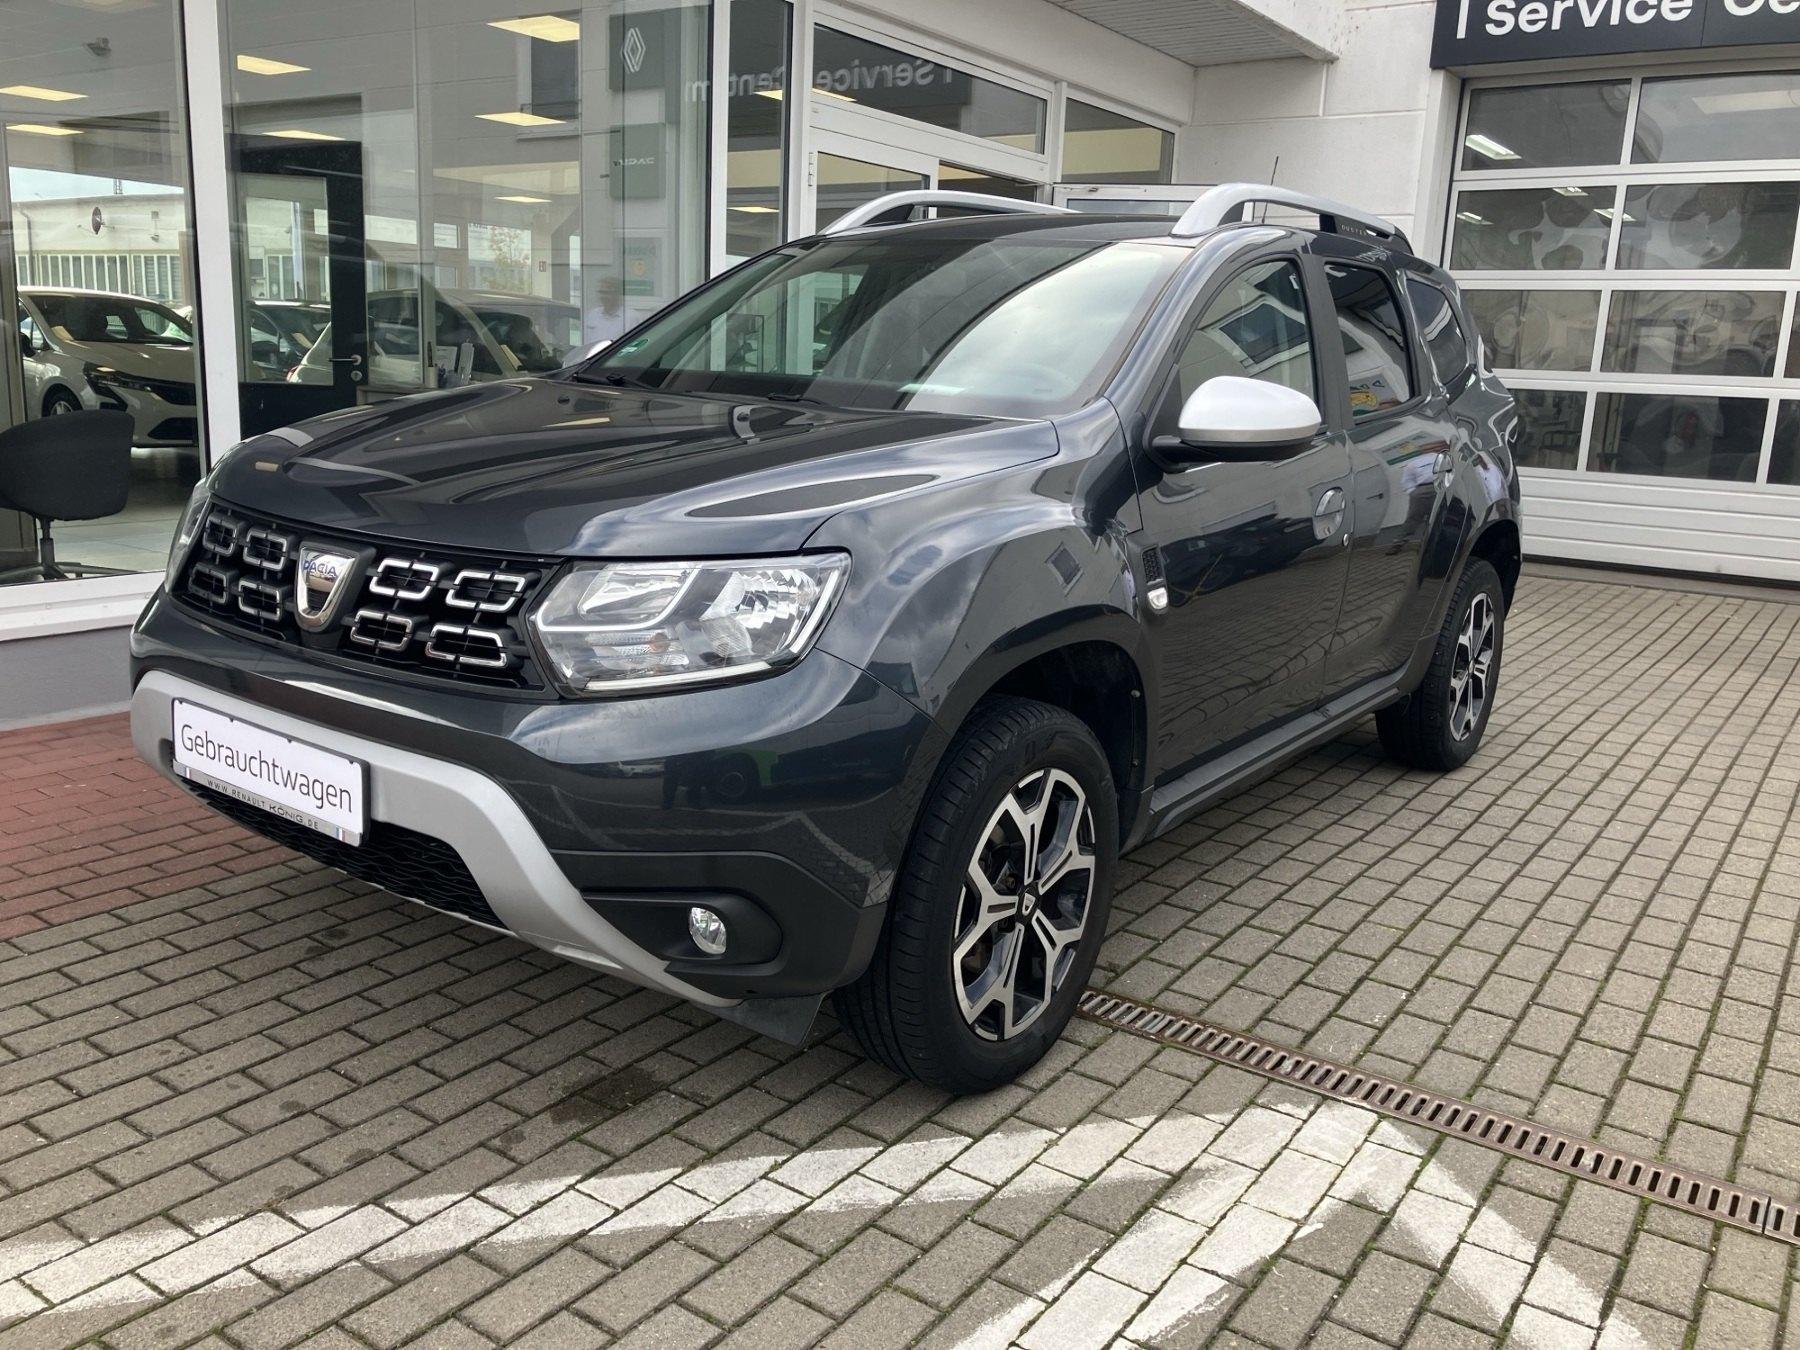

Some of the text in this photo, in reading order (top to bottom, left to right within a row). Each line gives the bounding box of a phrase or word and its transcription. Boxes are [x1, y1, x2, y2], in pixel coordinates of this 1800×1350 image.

[1485, 0, 1694, 36] Service
[303, 559, 338, 577] DACIA
[180, 723, 353, 814] Gebrauchtwagen
